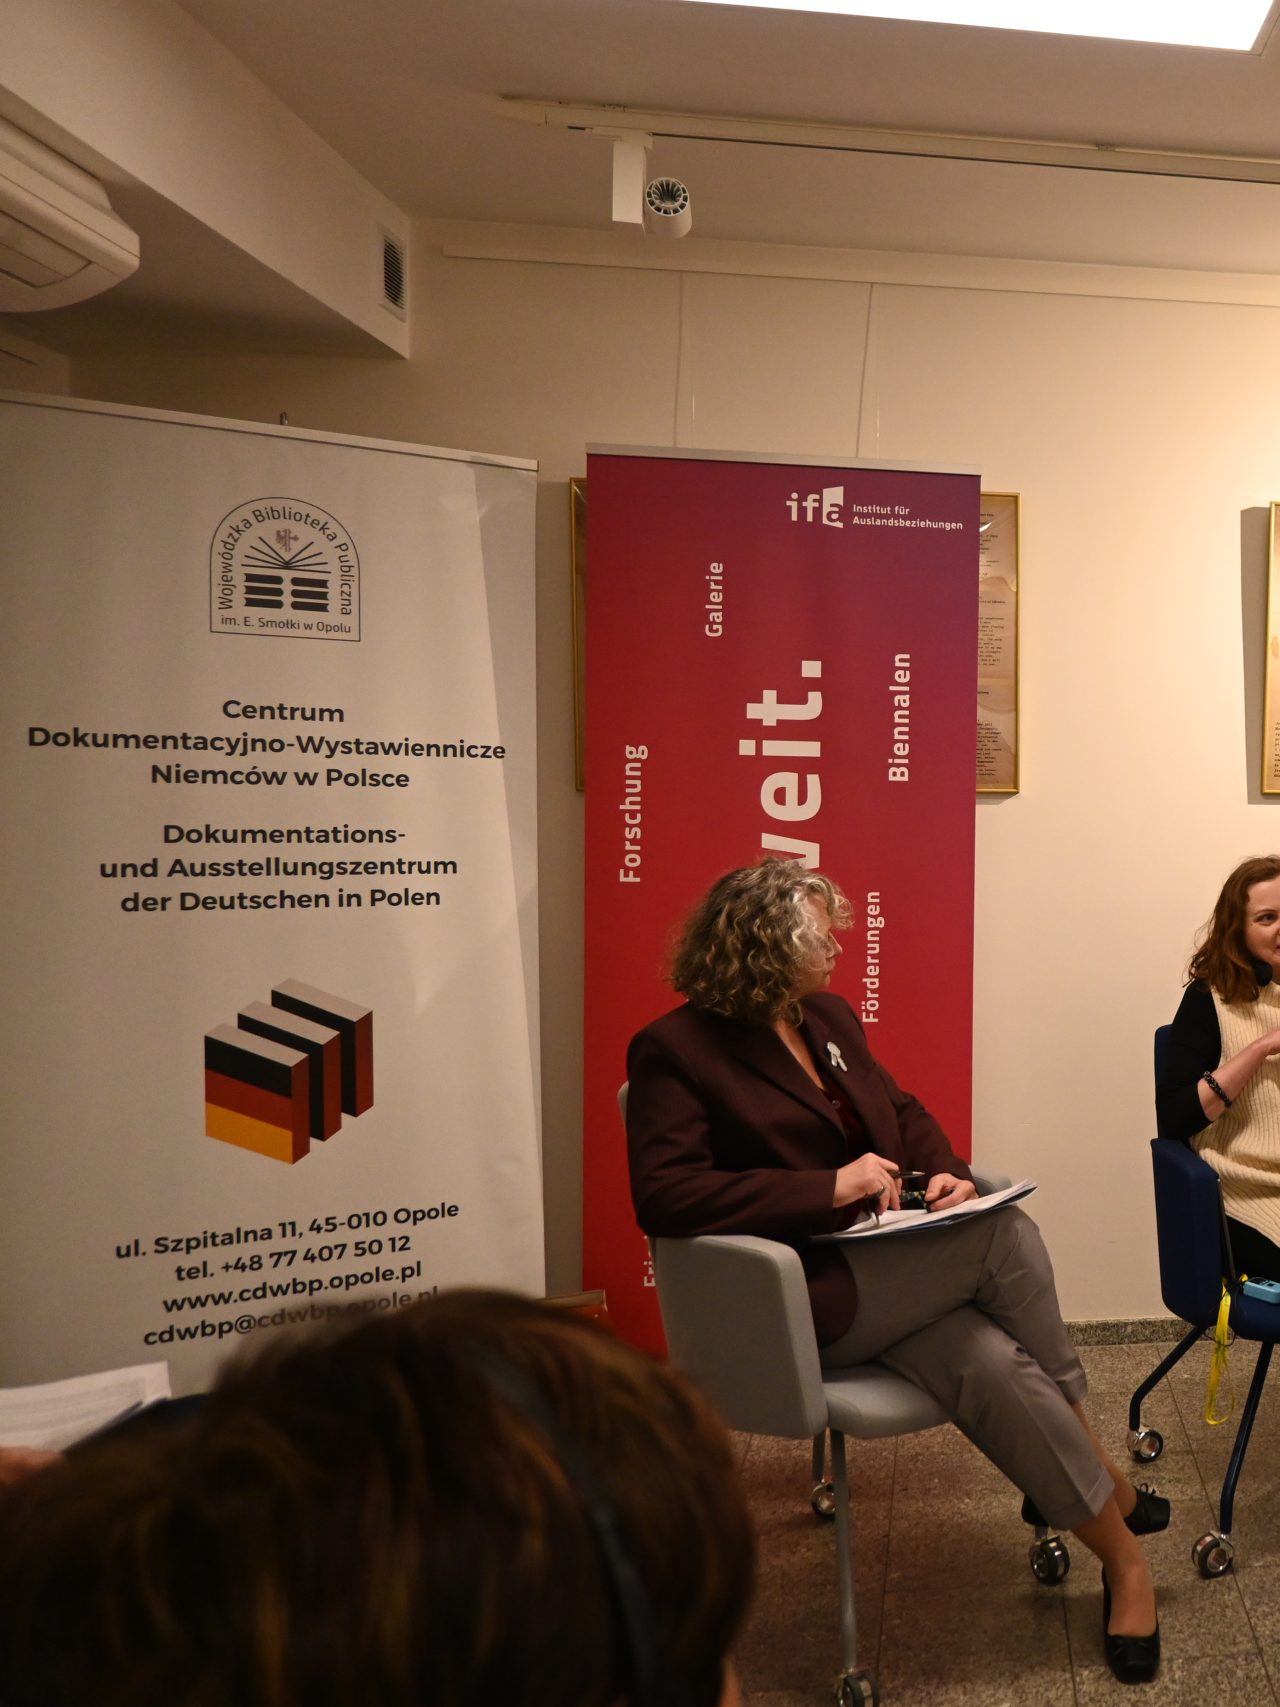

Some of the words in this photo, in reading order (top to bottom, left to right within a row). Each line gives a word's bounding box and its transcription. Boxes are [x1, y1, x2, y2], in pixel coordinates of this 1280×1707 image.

[786, 486, 844, 528] ifa
[852, 515, 963, 531] Auslandsbeziehungen
[853, 504, 891, 515] Institut
[894, 505, 910, 515] für
[218, 518, 253, 610] Wojewódzka
[252, 506, 337, 542] Biblioteka
[334, 542, 355, 616] Publiczna
[705, 562, 723, 638] Galerie
[221, 615, 240, 627] im.
[244, 616, 254, 627] E.
[258, 617, 300, 630] Smołki
[303, 622, 313, 631] w
[316, 621, 351, 634] Opolu
[222, 700, 345, 722] Centrum
[889, 653, 911, 782] Biennalen
[27, 726, 507, 760] Dokumentacyjno-Wystawiennicze
[151, 763, 287, 786] Niemców
[294, 769, 319, 786] w
[326, 768, 410, 788] Polsce
[619, 744, 648, 883] Forschung
[163, 824, 406, 844] Dokumentations-
[100, 858, 159, 878] und
[167, 856, 458, 881] Ausstellungszentrum
[120, 891, 171, 912] der
[180, 888, 330, 911] Deutschen
[338, 888, 362, 908] in
[370, 887, 441, 907] Polen
[862, 891, 885, 1023] Förderungen
[115, 1239, 147, 1259] ul.
[154, 1226, 273, 1255] Szpitalna
[278, 1220, 304, 1239] 11,
[309, 1210, 388, 1235] 45-010
[393, 1202, 460, 1226] Opole
[175, 1263, 215, 1283] tel.
[221, 1254, 264, 1274] +48
[269, 1250, 297, 1268] 77
[303, 1243, 347, 1264] 407
[354, 1238, 383, 1257] 50
[389, 1235, 411, 1252] 12
[163, 1260, 422, 1313] www.cdwbp.opole.pl
